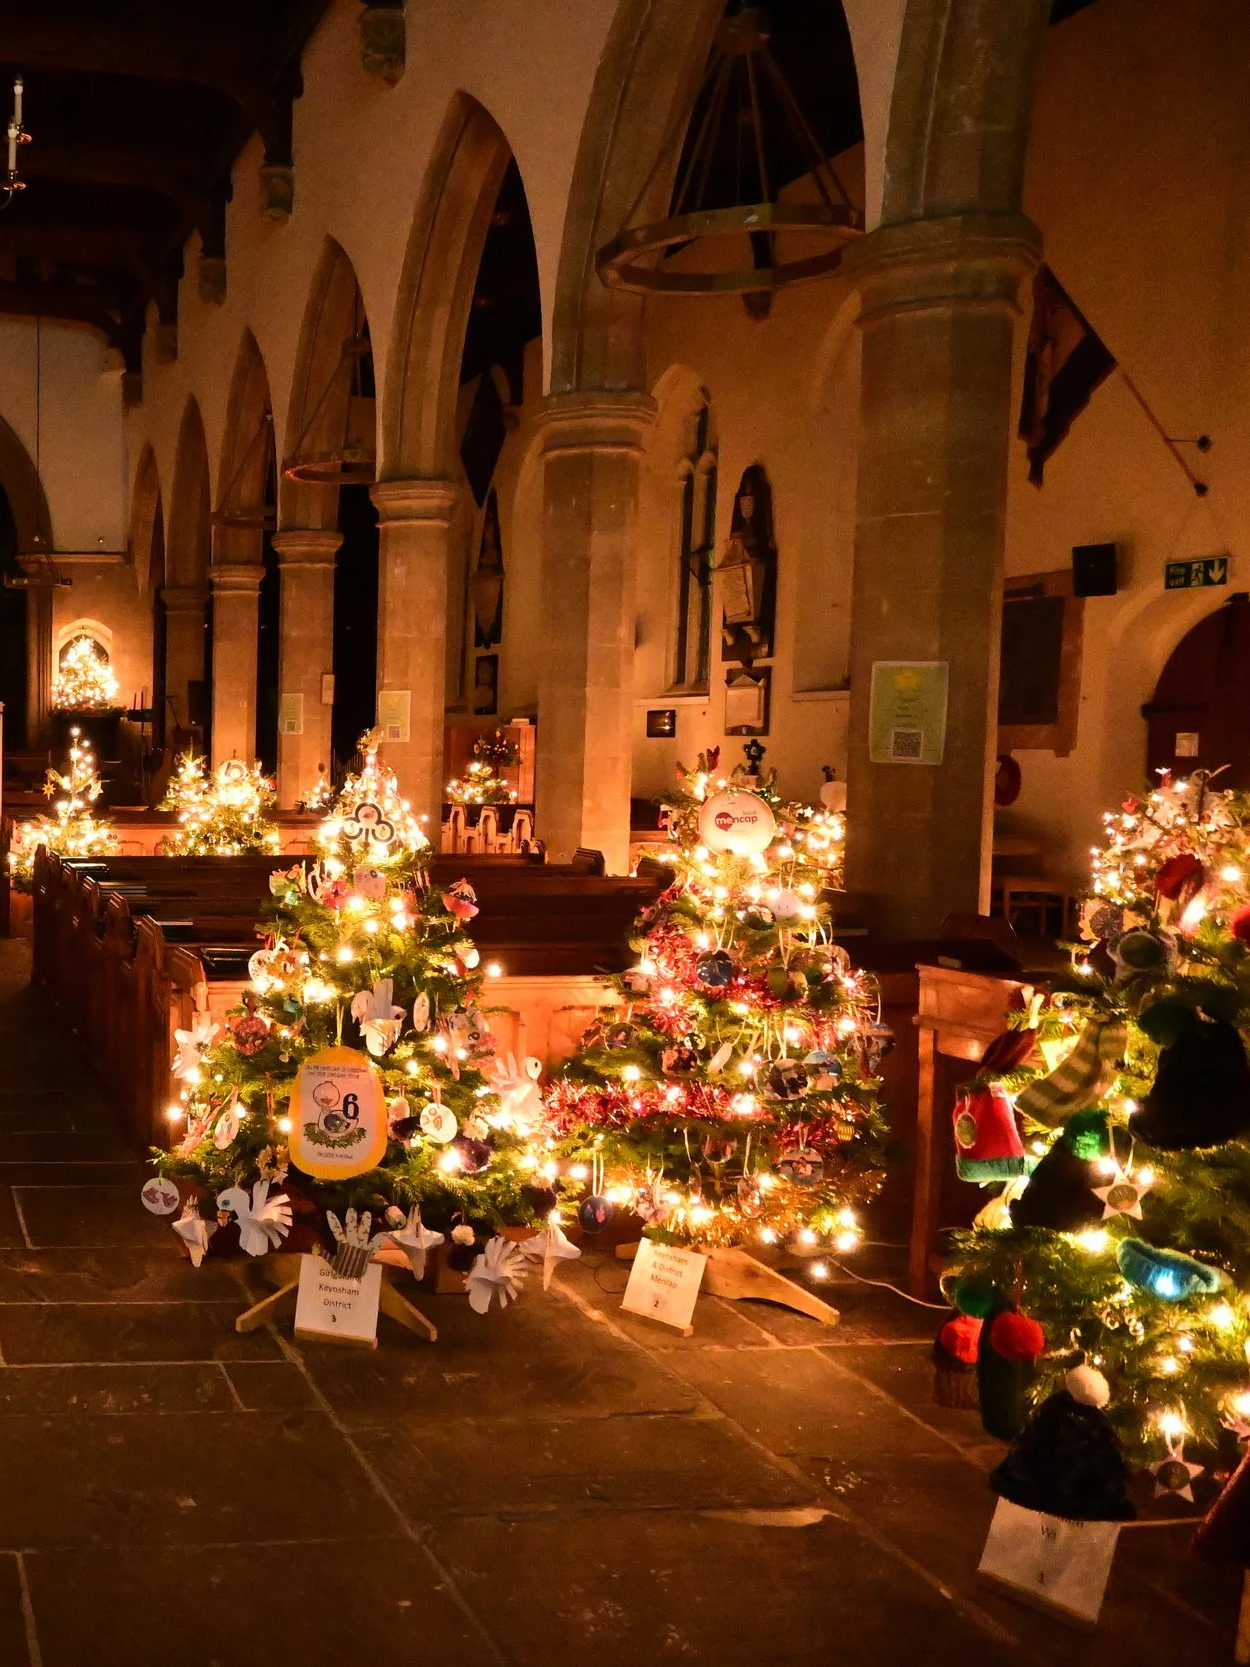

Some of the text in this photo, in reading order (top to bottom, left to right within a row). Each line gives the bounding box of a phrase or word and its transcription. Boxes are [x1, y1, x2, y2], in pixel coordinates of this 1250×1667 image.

[715, 816, 758, 825] mencap
[343, 1093, 360, 1120] 6
[318, 1283, 360, 1296] Keynsham
[323, 1298, 352, 1310] District
[653, 1300, 660, 1308] 2
[331, 1314, 337, 1323] 3
